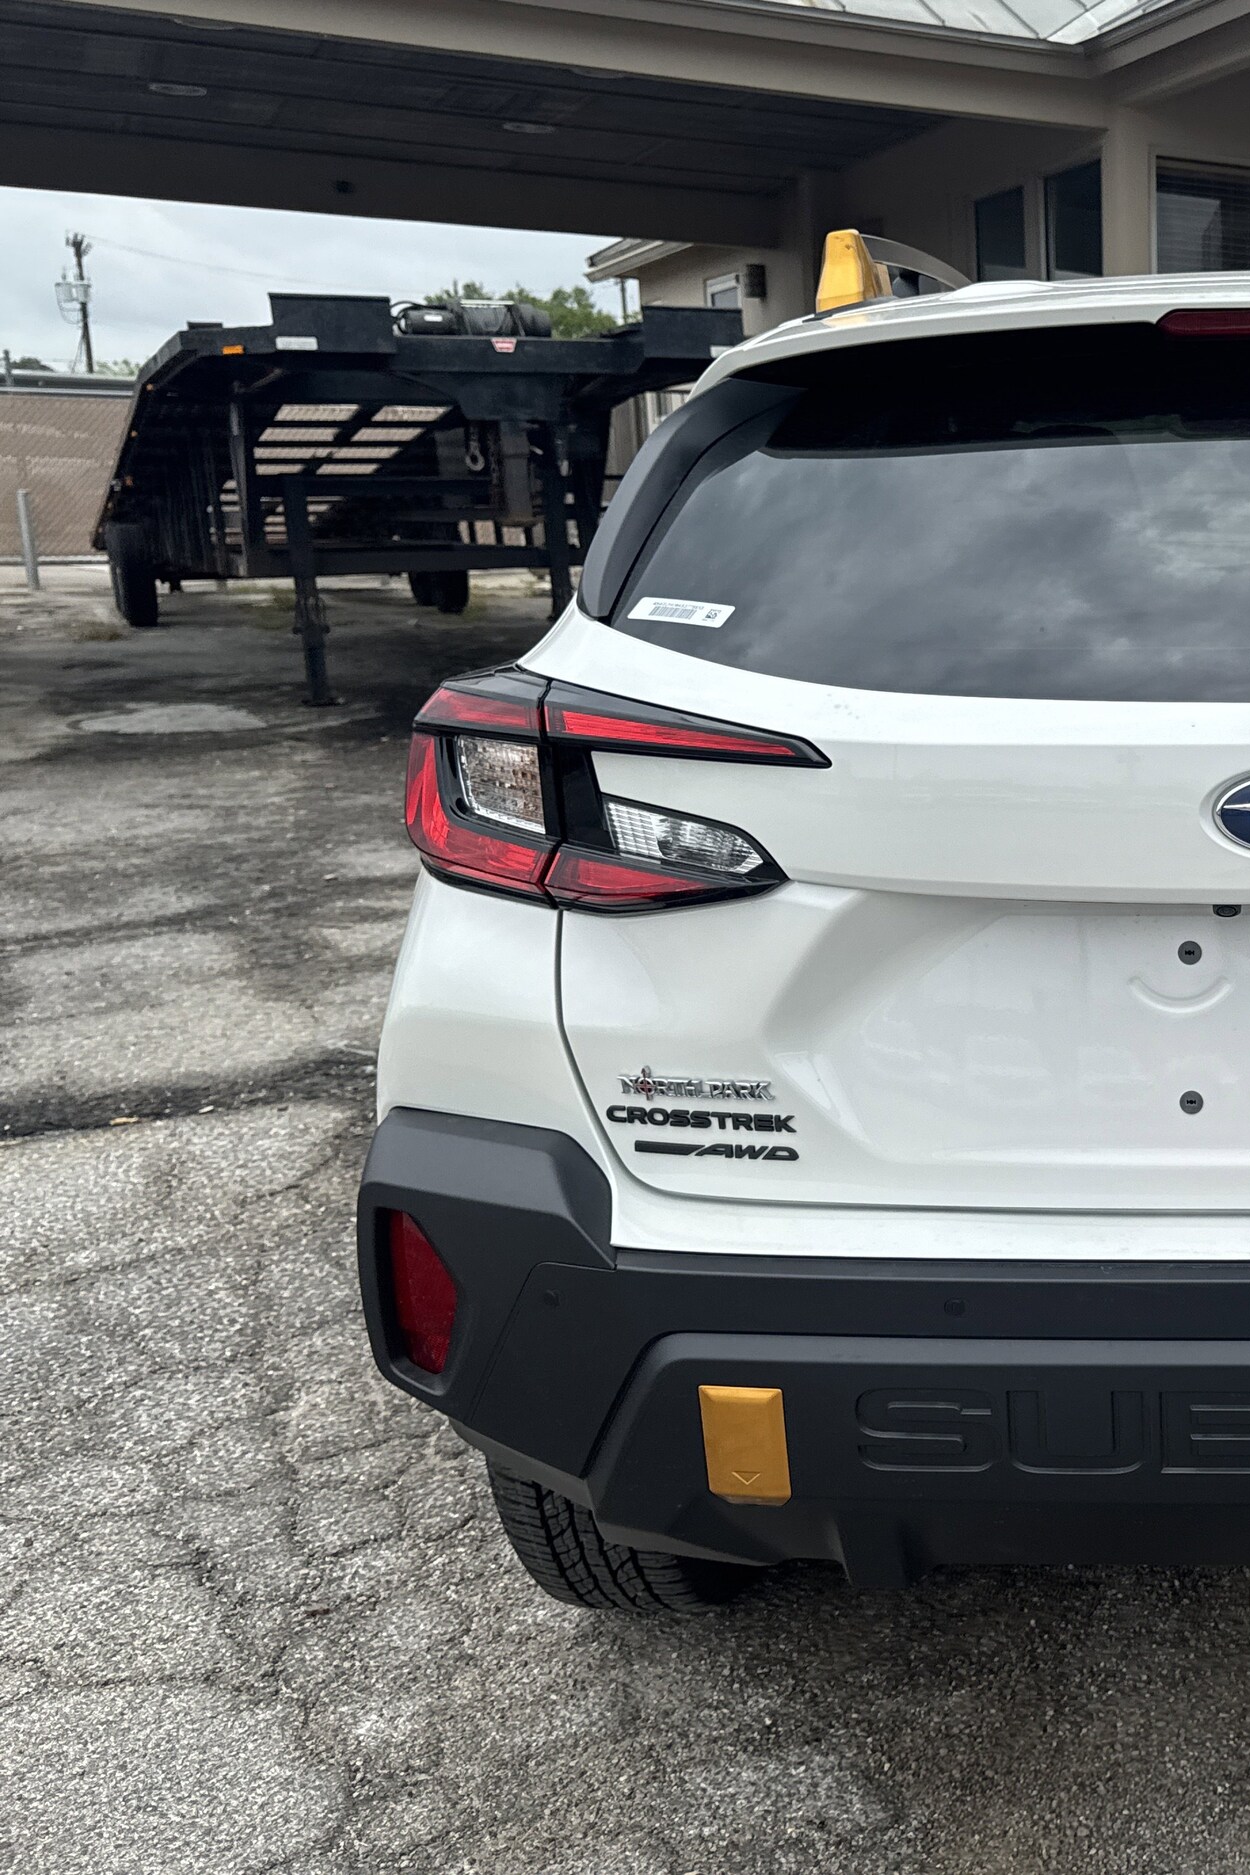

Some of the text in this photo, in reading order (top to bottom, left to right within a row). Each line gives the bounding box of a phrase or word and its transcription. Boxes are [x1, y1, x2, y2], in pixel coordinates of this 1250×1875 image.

[617, 1069, 776, 1100] NORTH PARK
[606, 1104, 797, 1133] CROSSTREK
[694, 1143, 800, 1161] AWD
